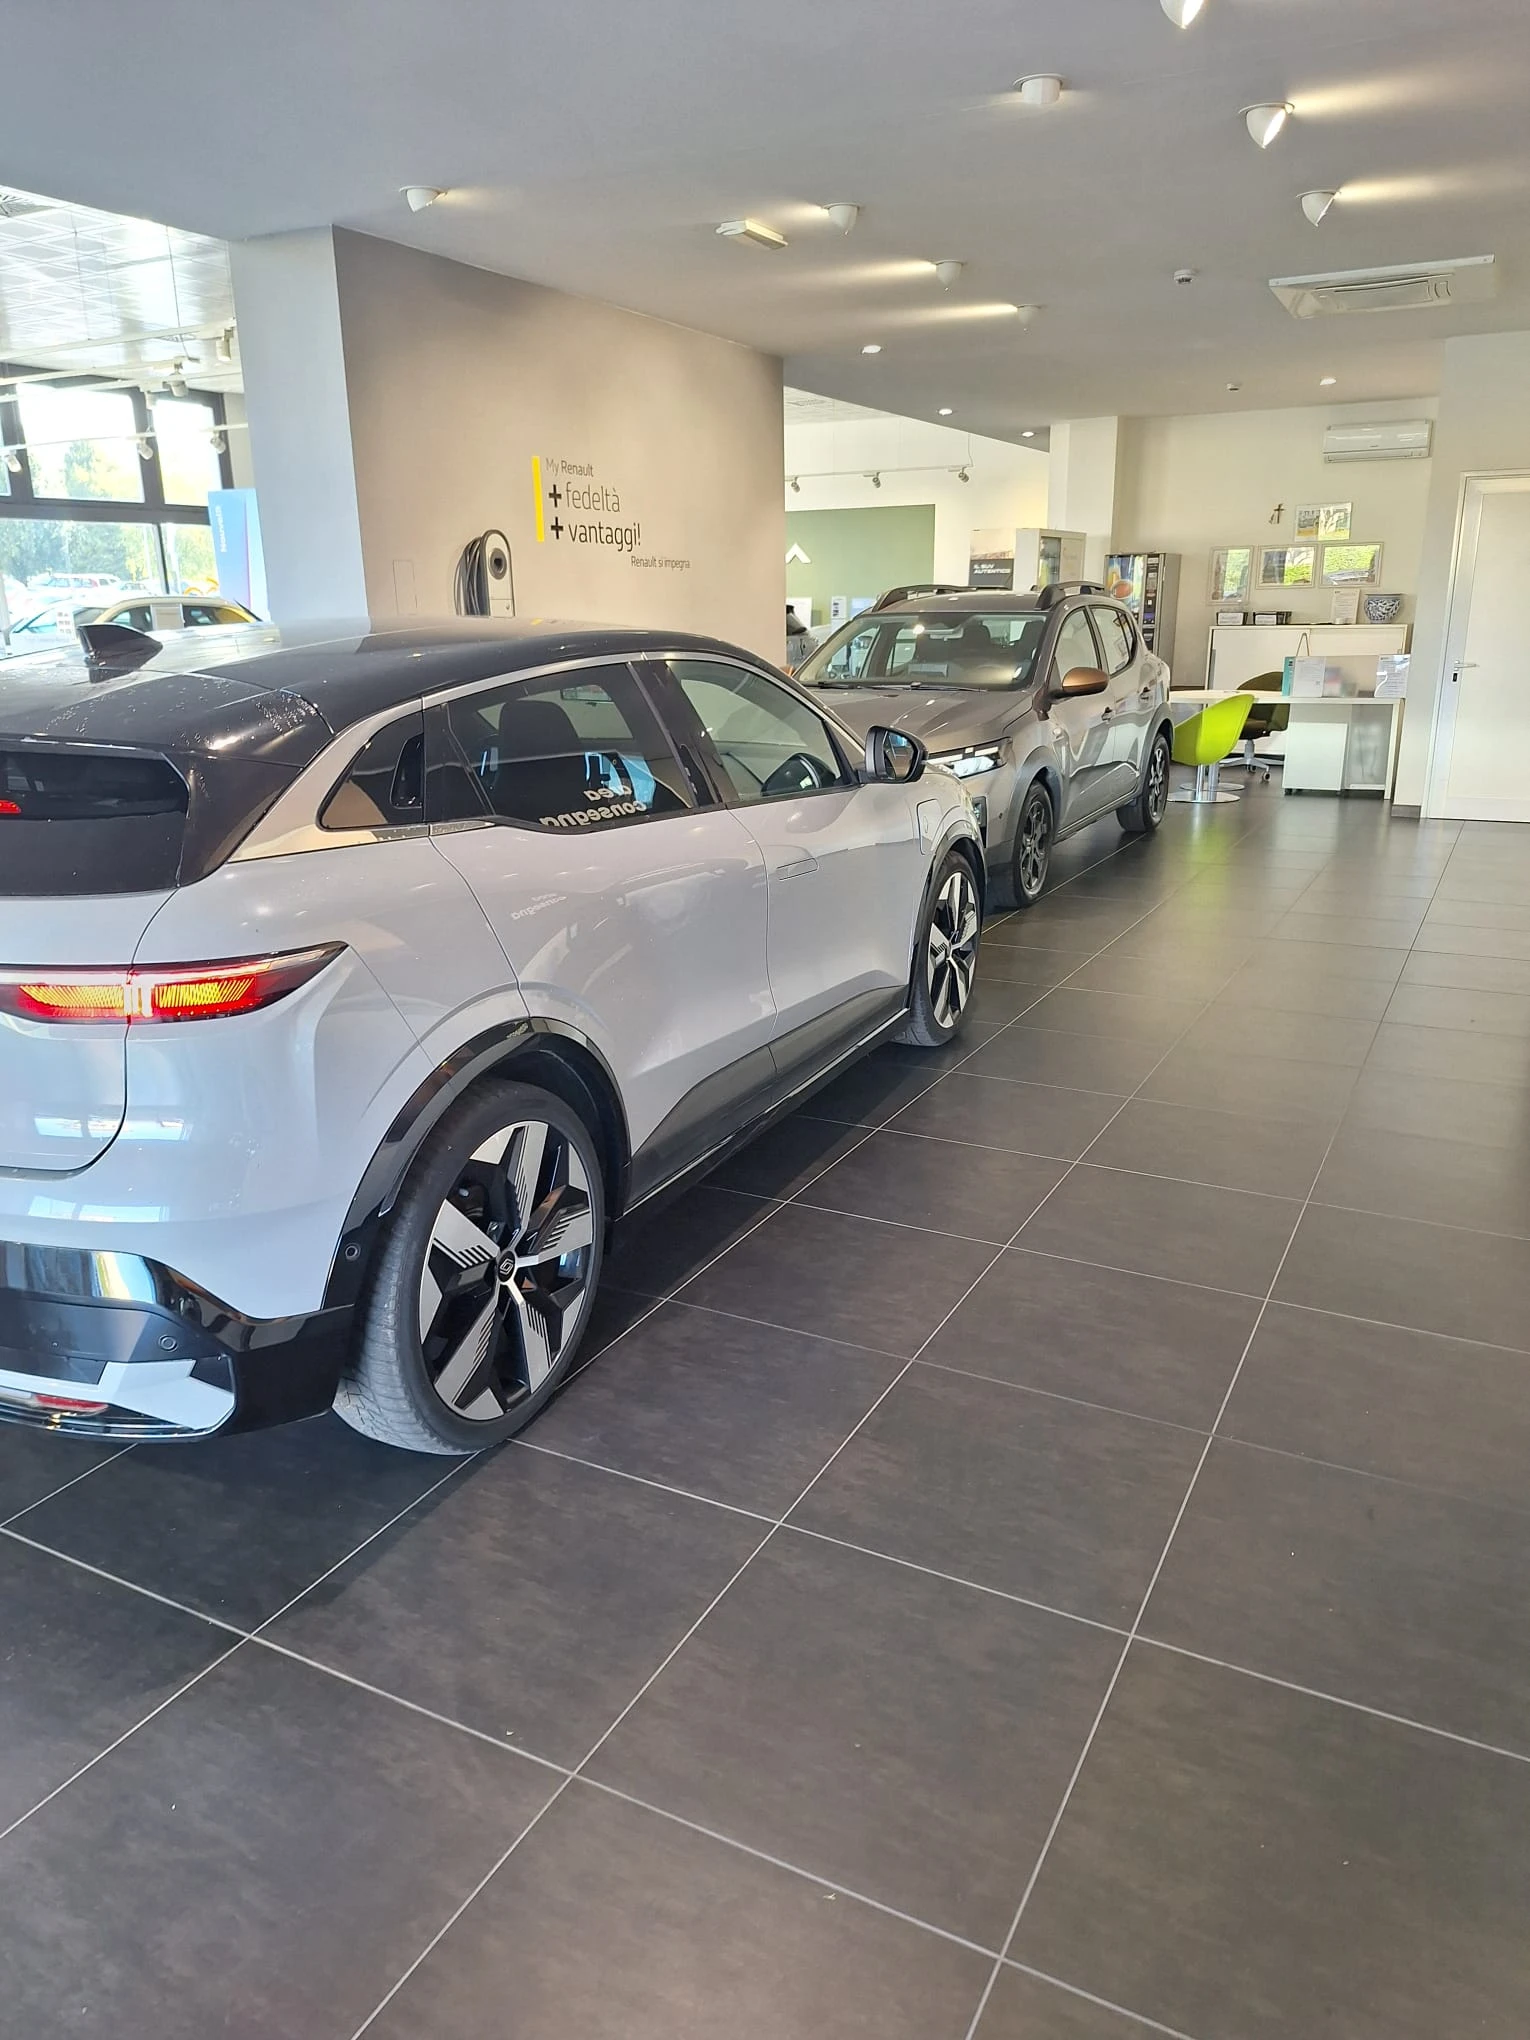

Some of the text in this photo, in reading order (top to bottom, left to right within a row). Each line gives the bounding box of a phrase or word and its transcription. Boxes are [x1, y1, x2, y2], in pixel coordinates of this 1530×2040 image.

[545, 457, 594, 477] My Renault
[566, 481, 621, 513] fedeltà
[568, 520, 642, 552] vantaggi!
[631, 555, 657, 568] Renault
